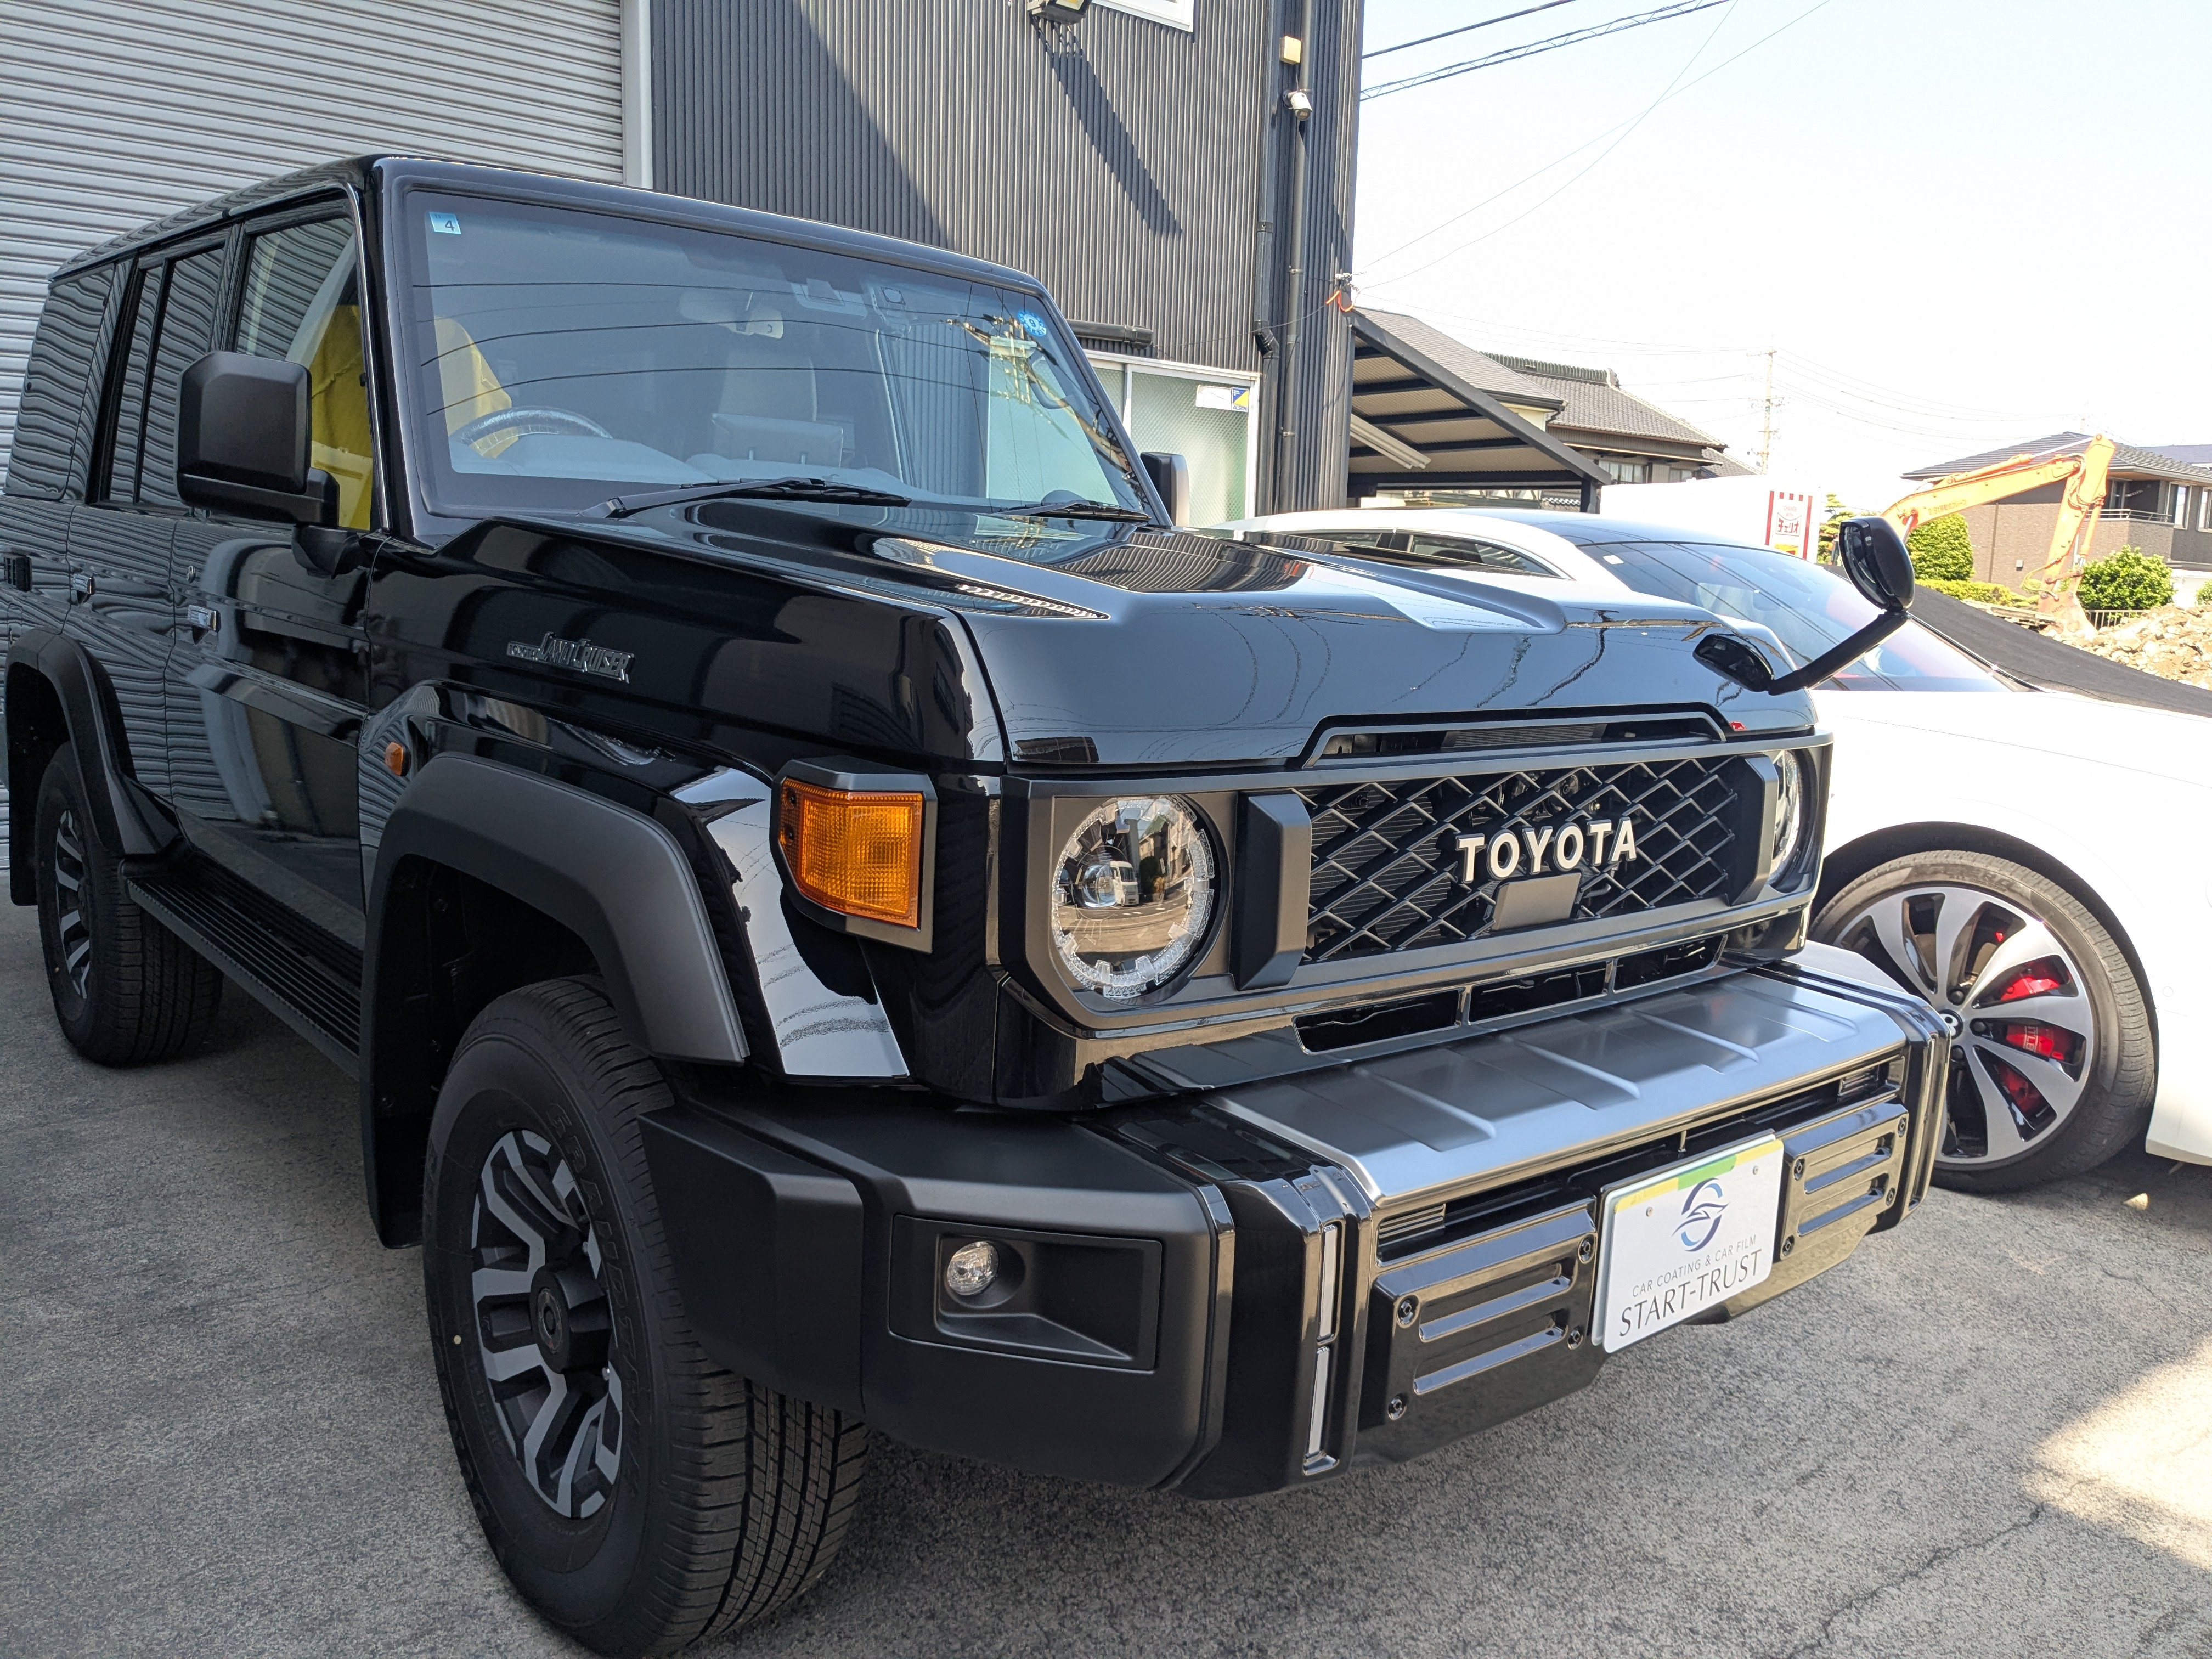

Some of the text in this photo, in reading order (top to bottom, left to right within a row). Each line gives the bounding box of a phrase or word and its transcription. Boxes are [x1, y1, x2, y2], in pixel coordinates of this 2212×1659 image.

[445, 220, 455, 232] 4
[1029, 319, 1036, 328] 9
[1778, 517, 1799, 534] チェリオ
[1455, 816, 1637, 884] TOYOTA
[1632, 1234, 1757, 1297] CAR COATING & CAR FILM
[1620, 1249, 1762, 1337] START-TRUST
